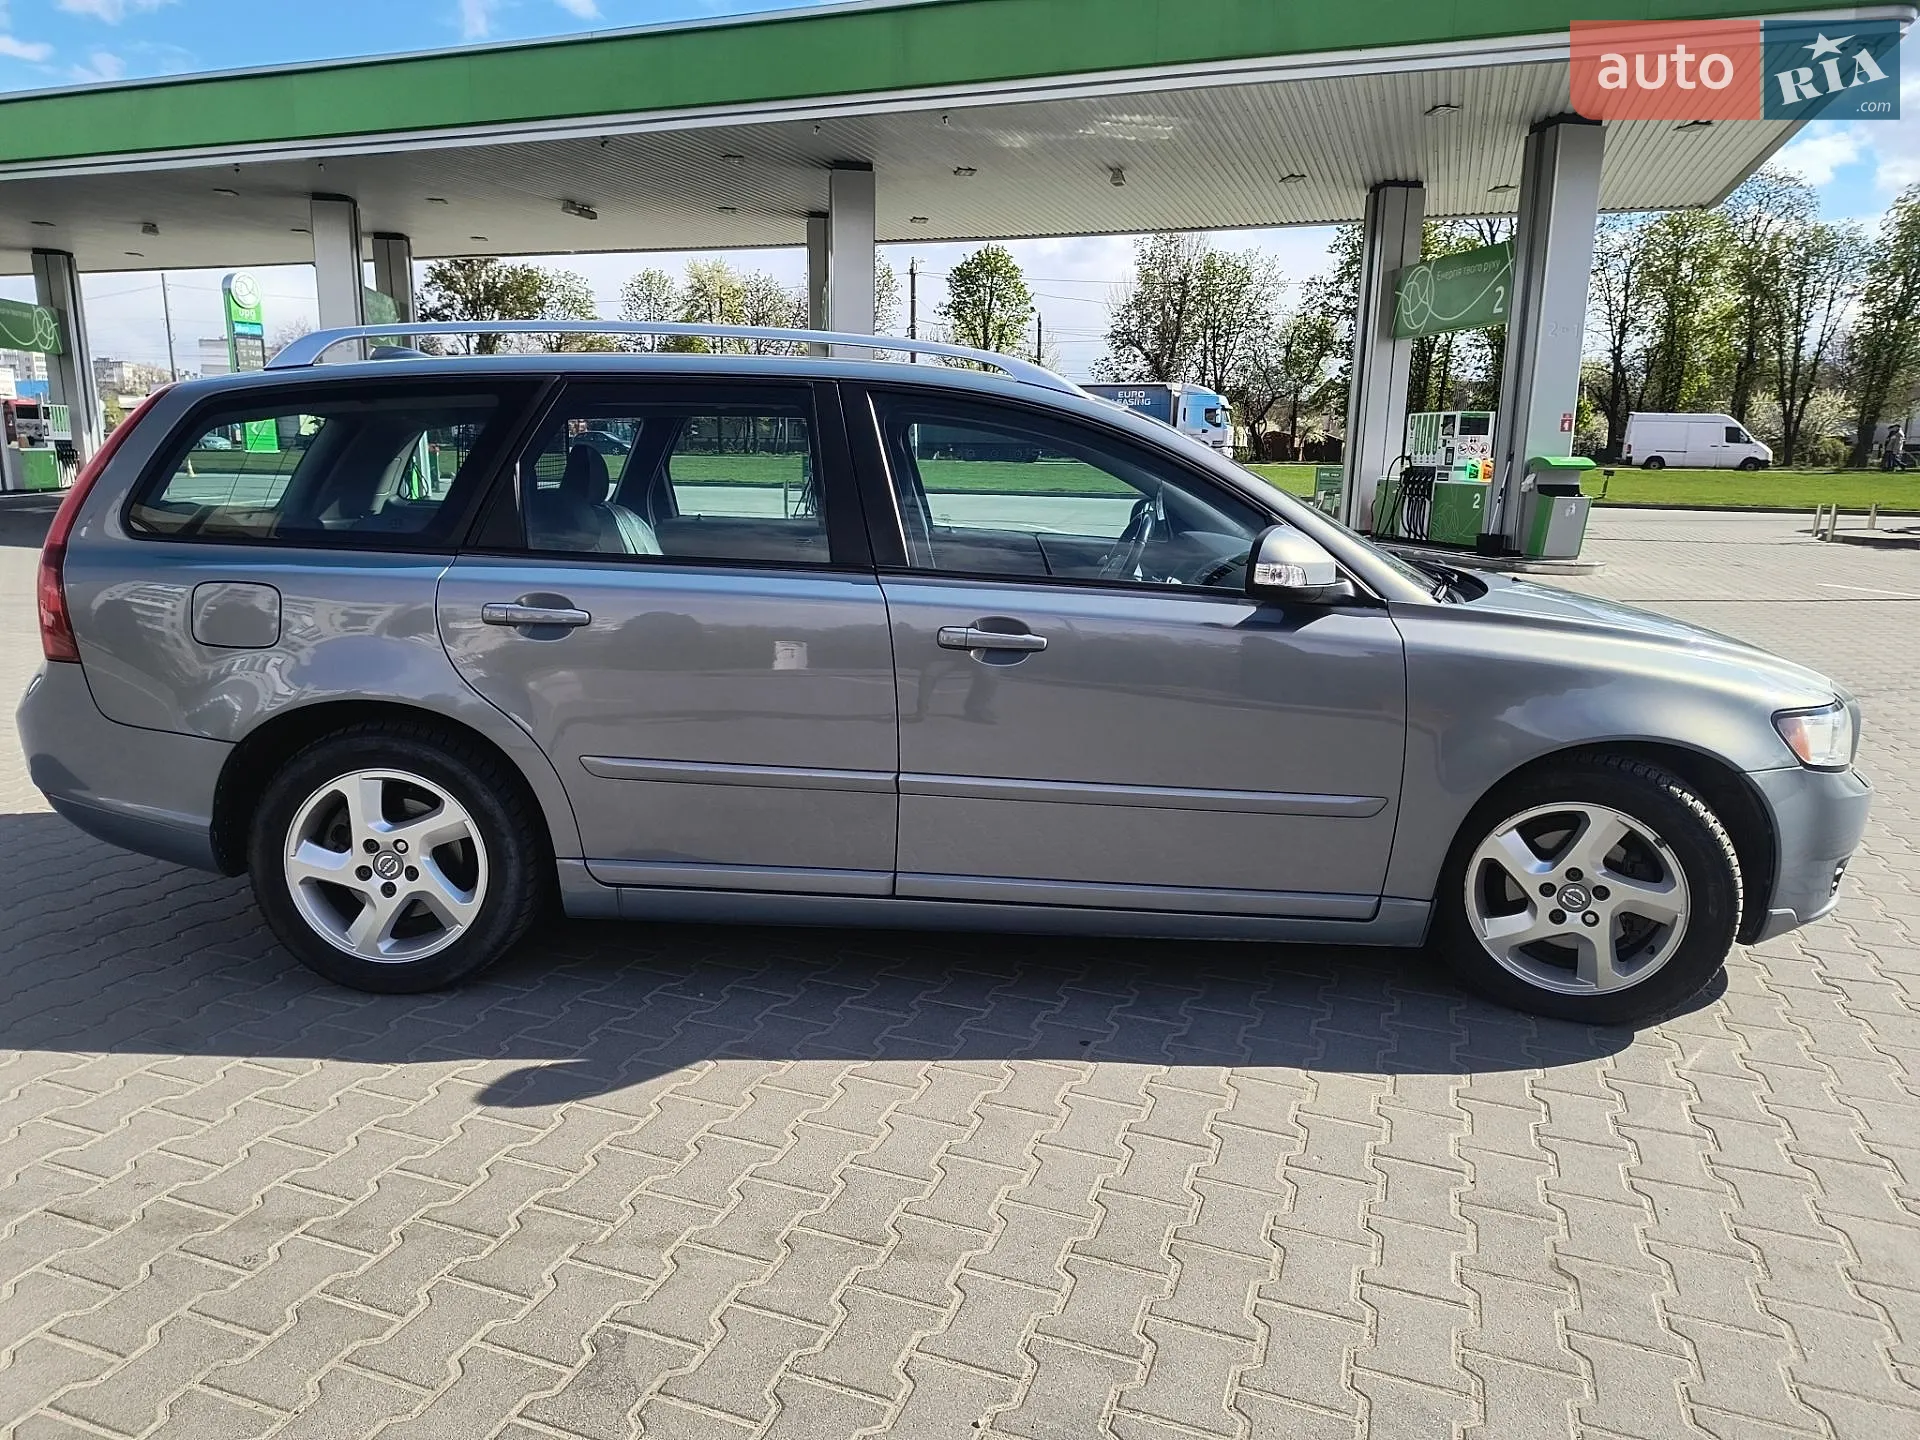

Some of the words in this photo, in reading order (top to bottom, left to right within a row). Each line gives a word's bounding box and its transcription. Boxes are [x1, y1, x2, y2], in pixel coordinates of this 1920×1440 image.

[1493, 285, 1505, 314] 2
[1118, 390, 1145, 398] EURO
[1111, 398, 1151, 406] EASING
[1472, 493, 1481, 509] 2
